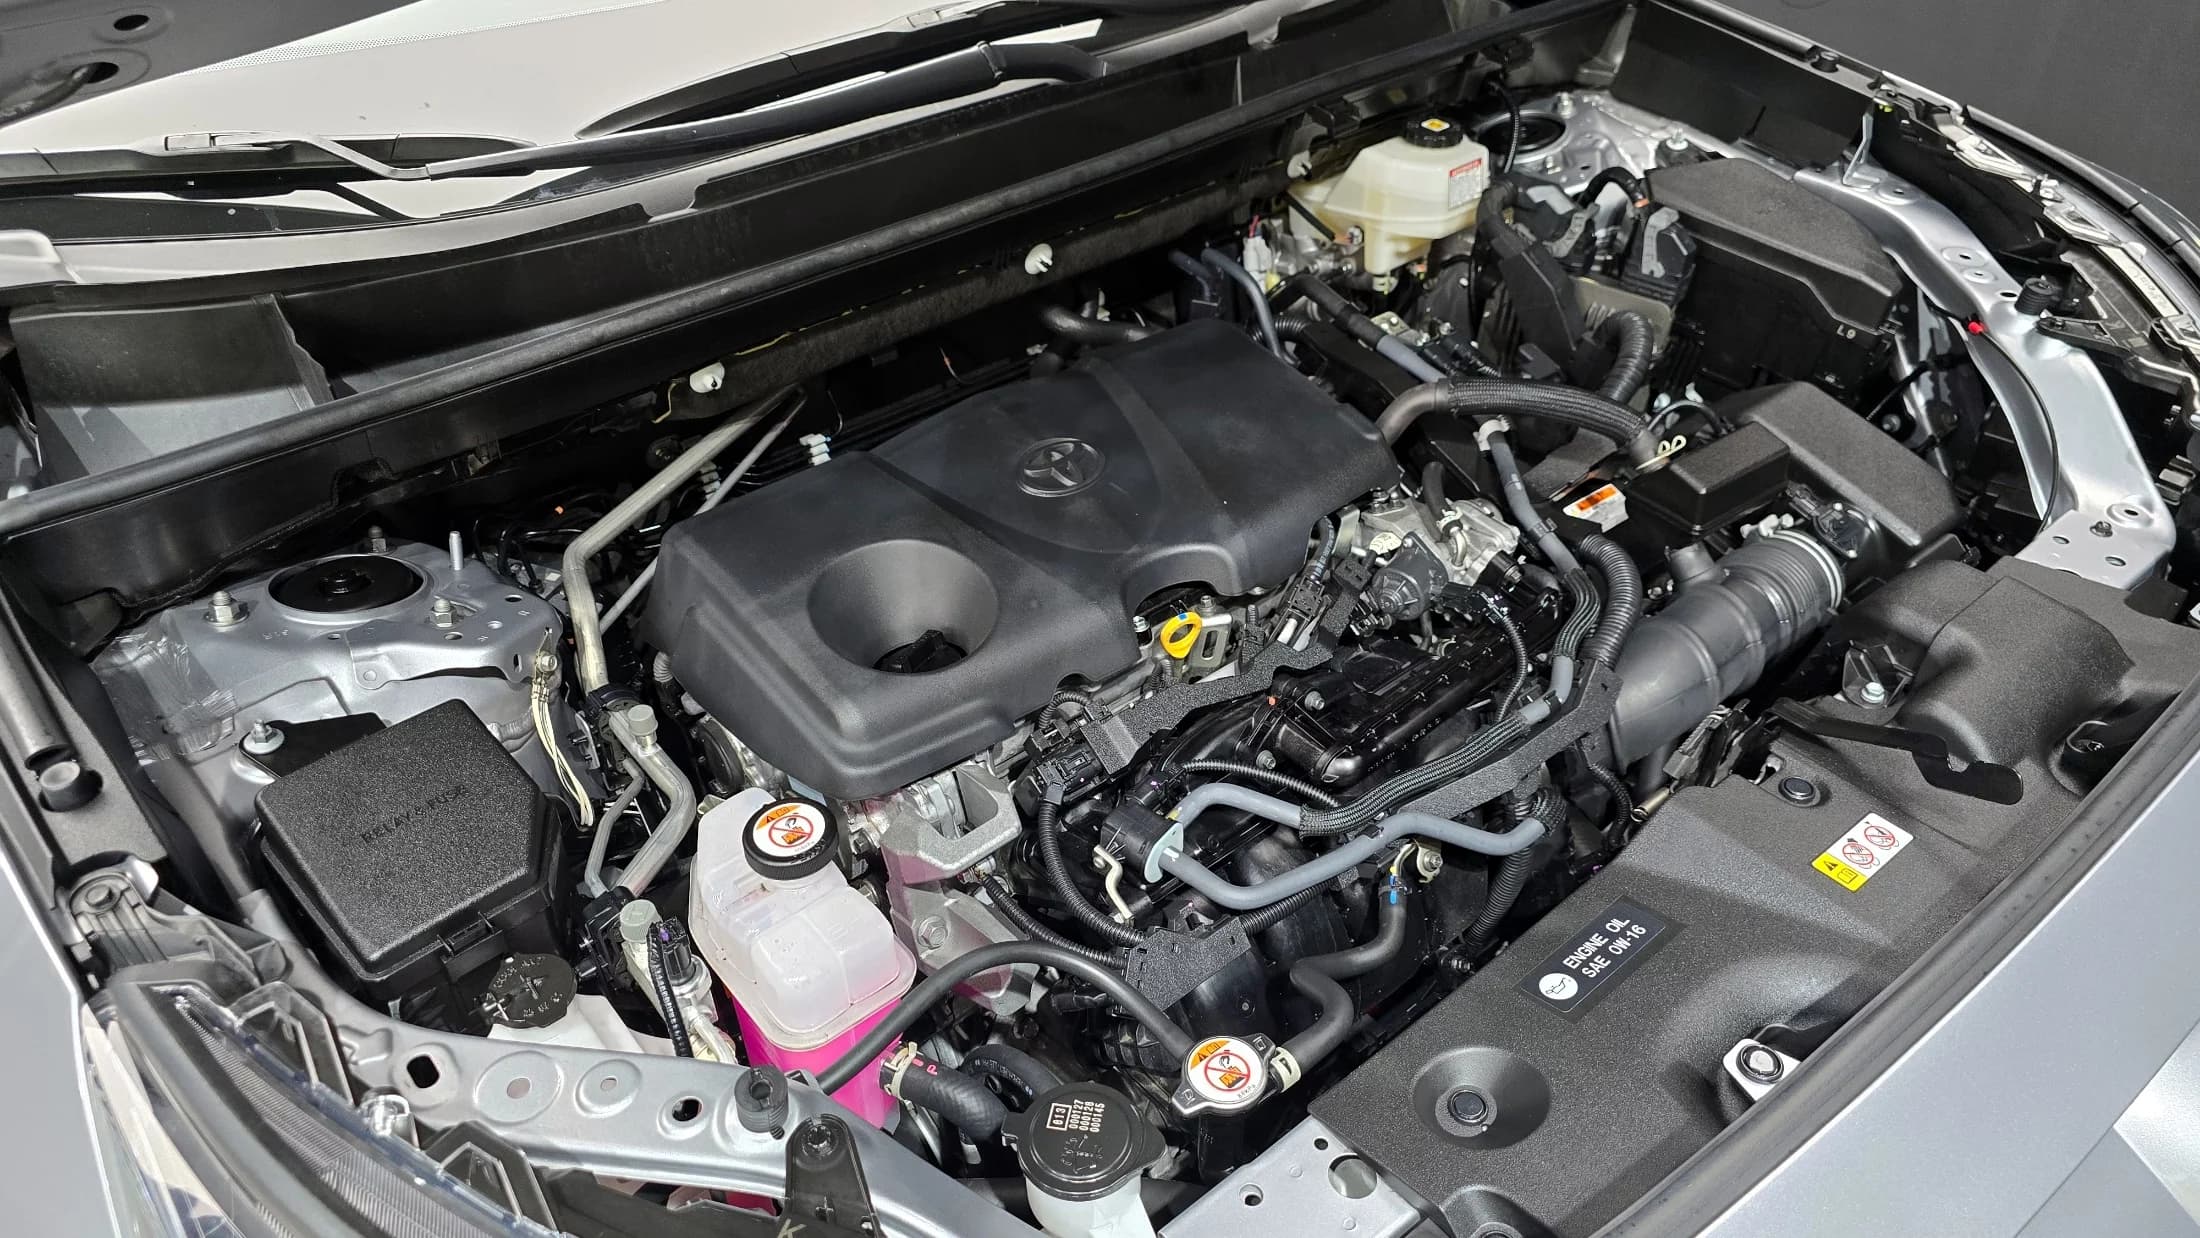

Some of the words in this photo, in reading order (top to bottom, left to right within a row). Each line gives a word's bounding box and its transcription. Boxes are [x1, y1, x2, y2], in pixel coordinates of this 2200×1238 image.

[360, 811, 412, 843] RELAY
[427, 783, 469, 811] FUSE
[1562, 932, 1610, 970] ENGINE
[1605, 918, 1631, 933] OIL
[1581, 955, 1612, 978] SAE
[1608, 924, 1647, 955] 0W-16
[1069, 1099, 1084, 1129] 000127
